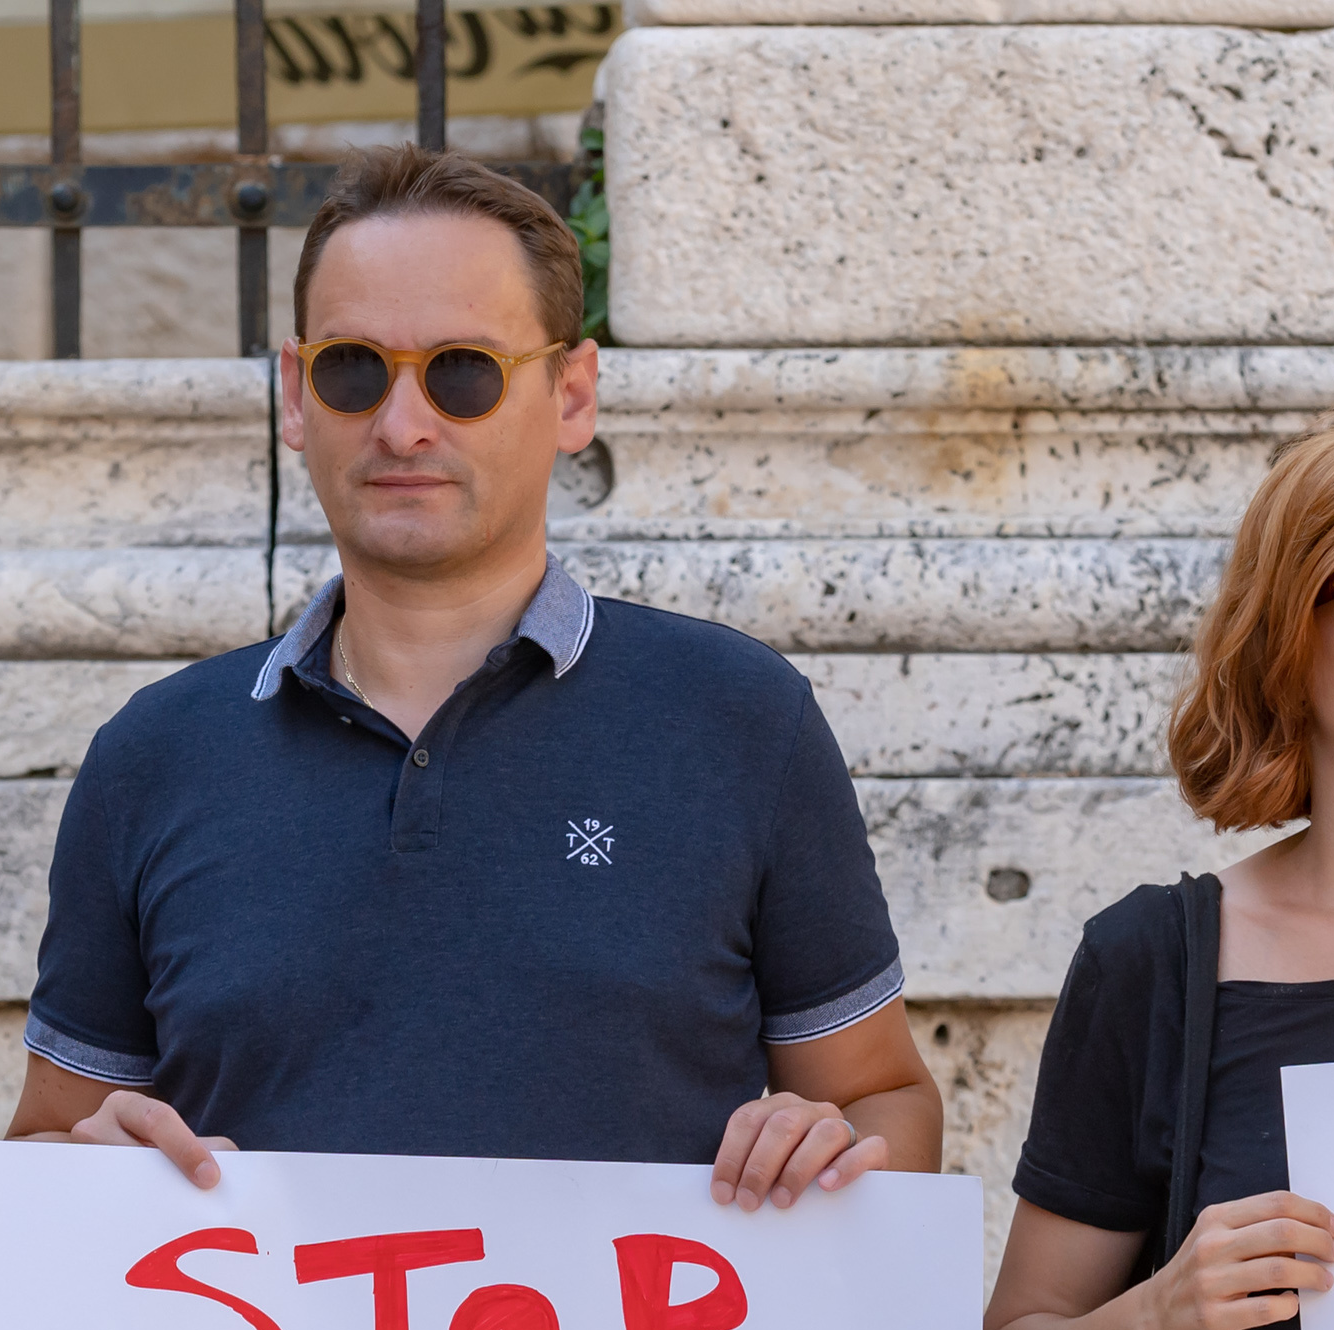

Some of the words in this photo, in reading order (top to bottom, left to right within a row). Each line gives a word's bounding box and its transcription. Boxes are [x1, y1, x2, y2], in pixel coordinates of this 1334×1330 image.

[583, 818, 600, 831] 19
[566, 833, 578, 848] T
[603, 837, 615, 852] T
[580, 853, 599, 866] 62
